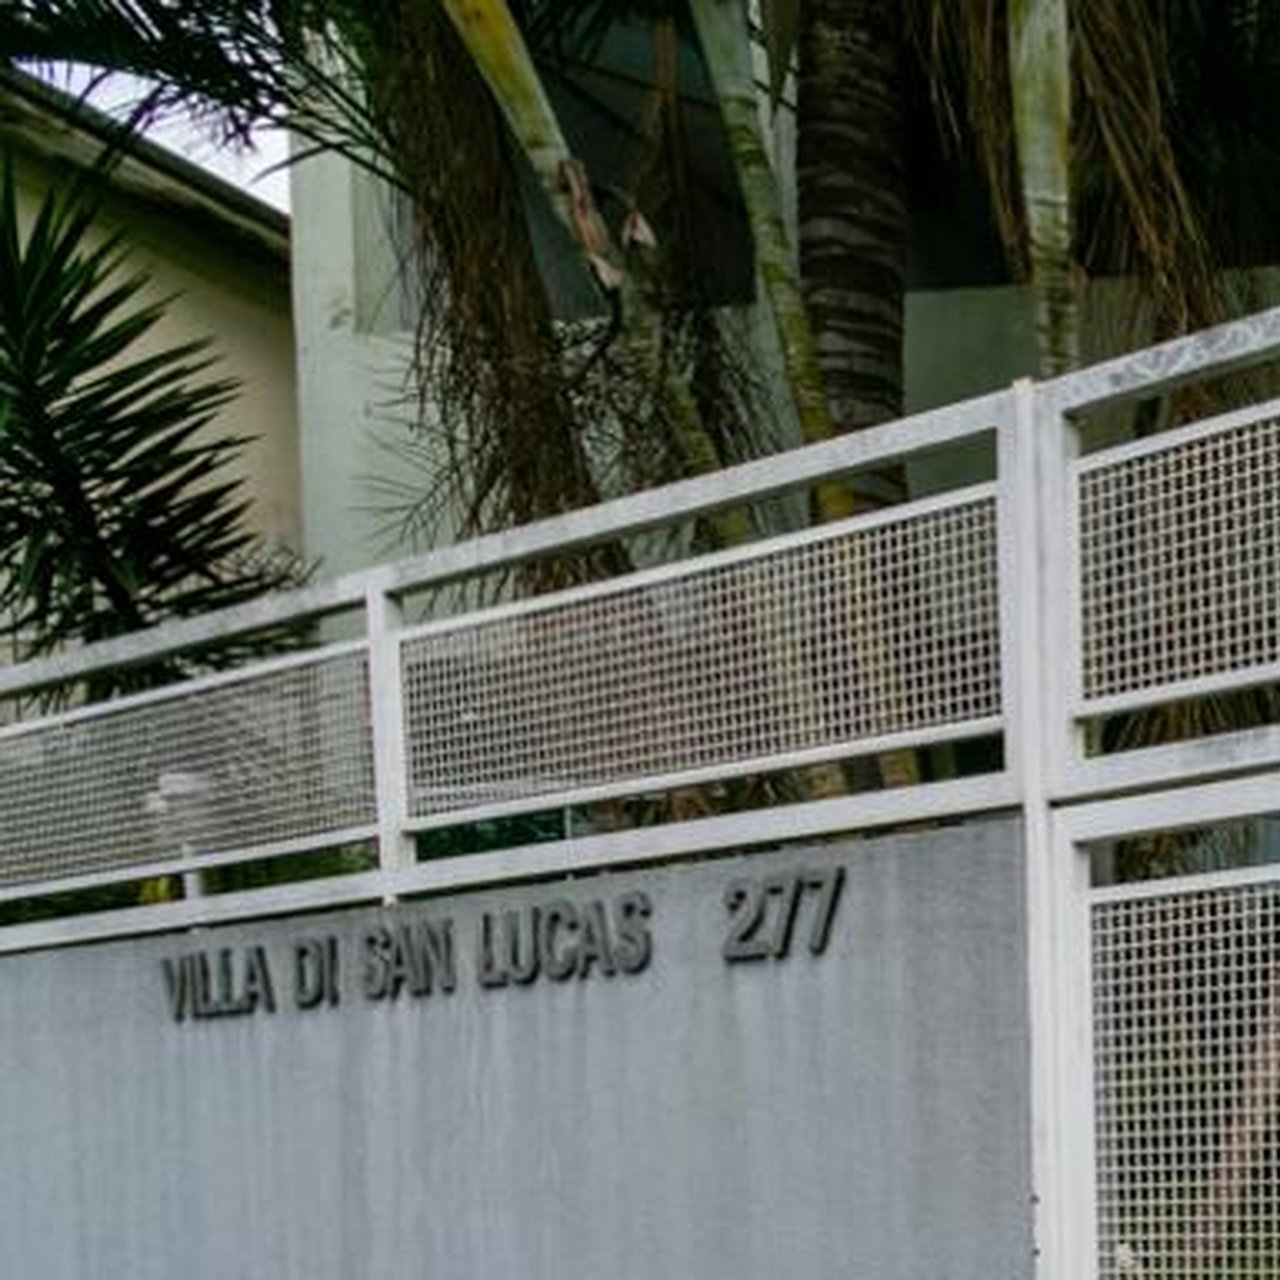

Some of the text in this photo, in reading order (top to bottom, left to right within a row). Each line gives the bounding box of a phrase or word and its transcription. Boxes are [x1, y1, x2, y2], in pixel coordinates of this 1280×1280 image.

[163, 867, 846, 1022] VILLA DI SAN LUCAS 277
